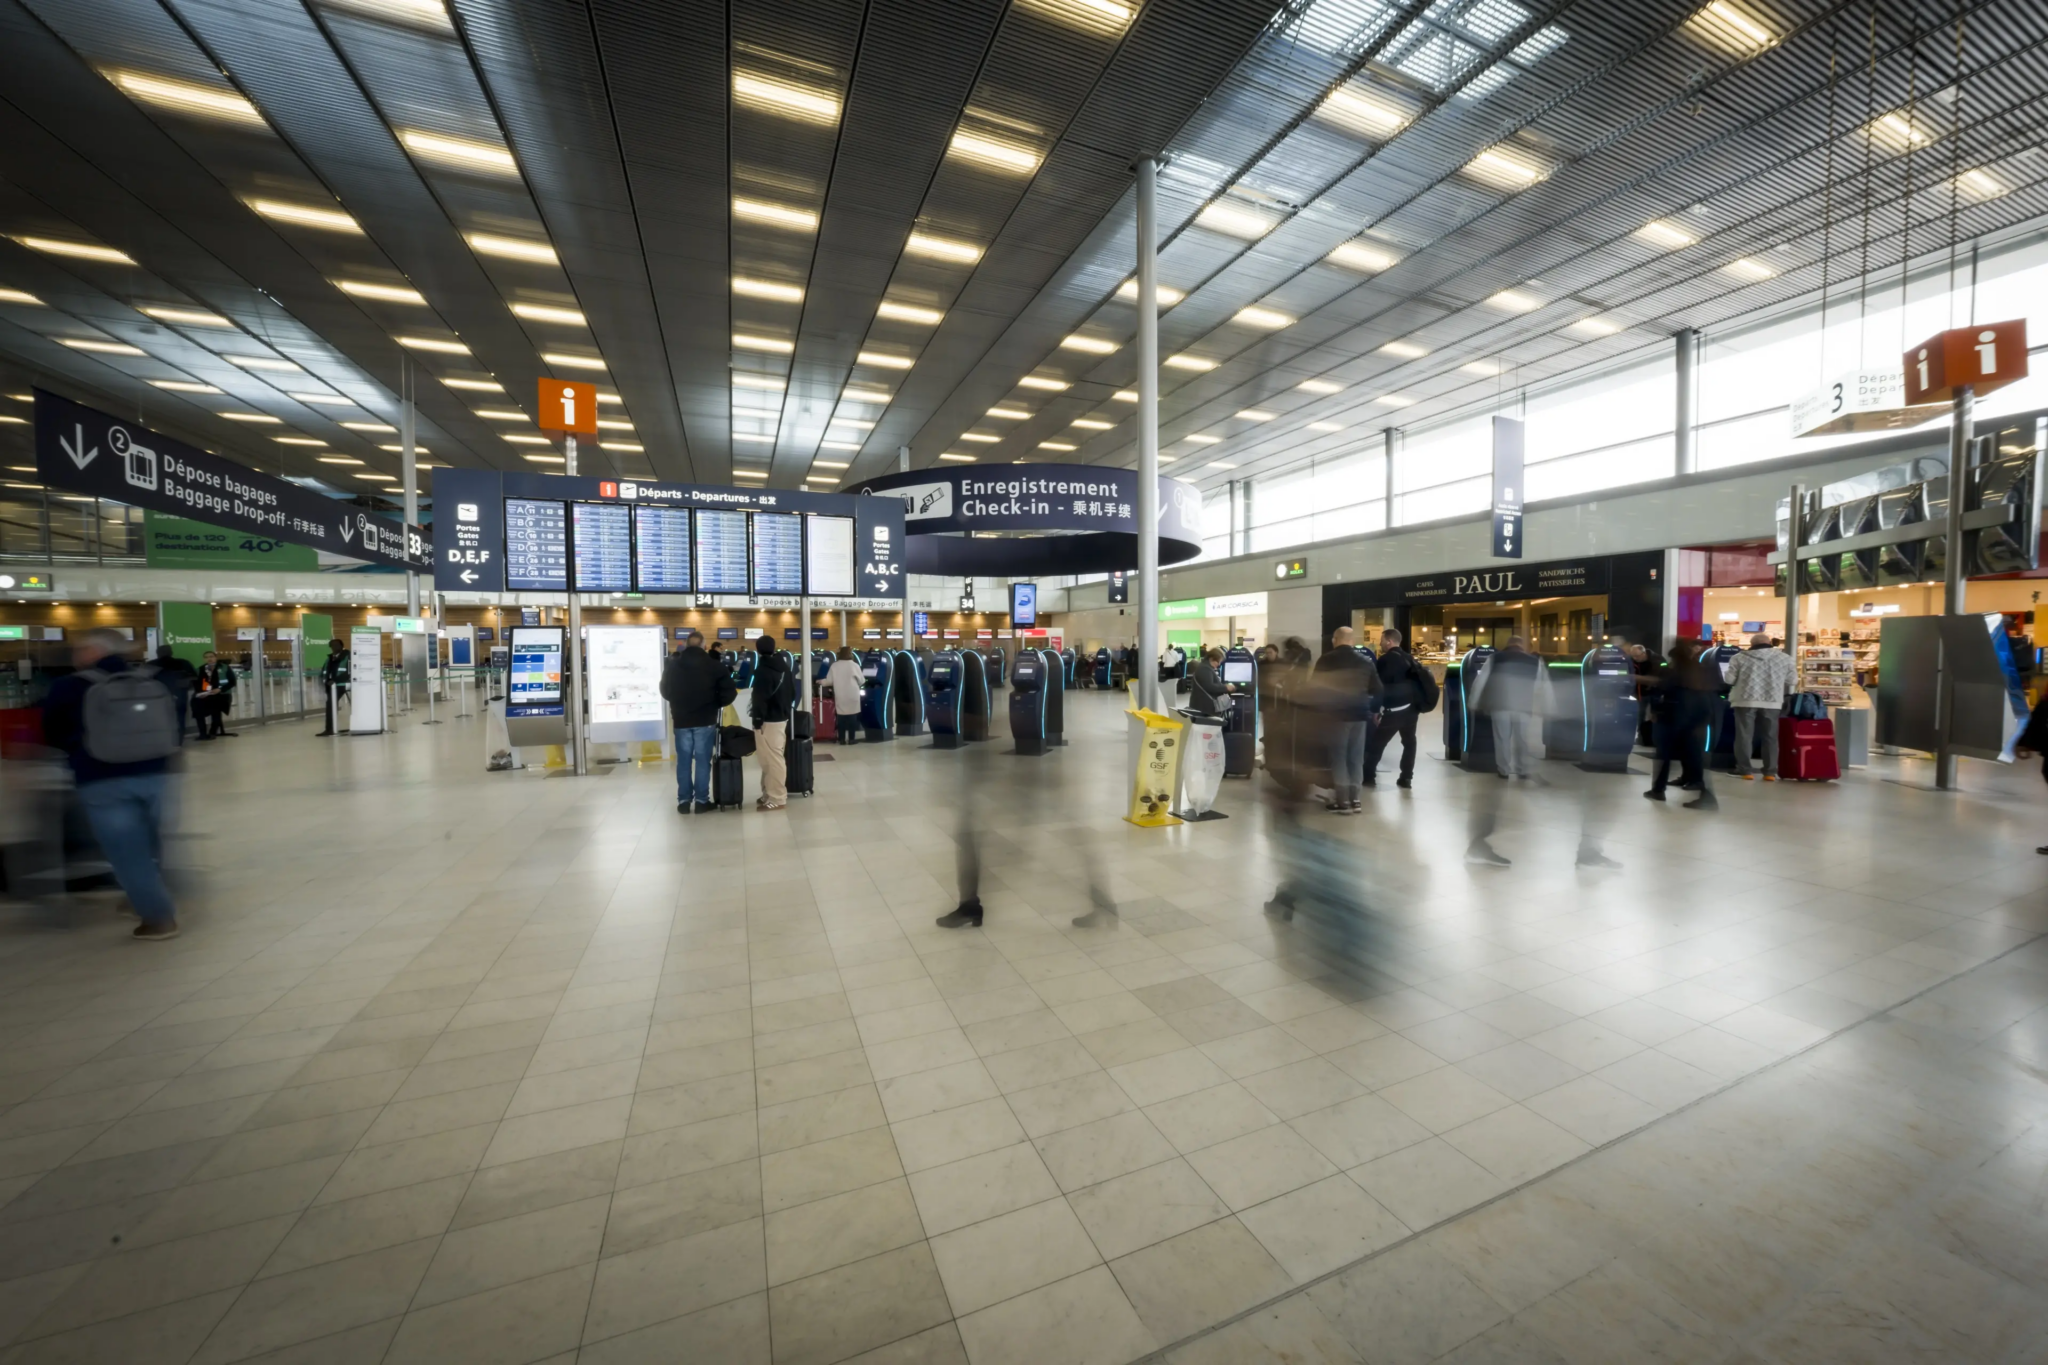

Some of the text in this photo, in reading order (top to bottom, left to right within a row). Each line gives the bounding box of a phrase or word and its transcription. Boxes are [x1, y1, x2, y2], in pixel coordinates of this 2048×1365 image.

[1859, 372, 1904, 384] Dépar
[1832, 382, 1843, 413] 3
[164, 454, 277, 505] Dépose bagages
[961, 478, 1118, 498] Enregistrement
[639, 487, 682, 499] Départs
[692, 491, 749, 503] Departures
[759, 496, 776, 505] 出发
[165, 479, 230, 513] Baggage
[234, 499, 285, 527] Drop-off
[293, 517, 325, 538] 行李托运
[962, 498, 1049, 516] Check-in
[1073, 500, 1131, 518] 乘机手续
[380, 527, 404, 543] Dépos
[155, 542, 230, 552] destinations
[381, 542, 405, 560] Bagga
[409, 533, 421, 555] 33
[448, 549, 490, 564] D,E,F
[865, 562, 898, 575] A,B,C
[1538, 567, 1585, 577] SANDWICHS
[1453, 572, 1522, 595] PAUL
[1538, 578, 1585, 588] PATISSERIES
[696, 594, 712, 605] 34
[763, 598, 791, 607] Dépose
[834, 599, 865, 608] Baggage
[868, 600, 899, 608] Drop-off
[961, 598, 974, 609] 34
[175, 635, 211, 644] transavia
